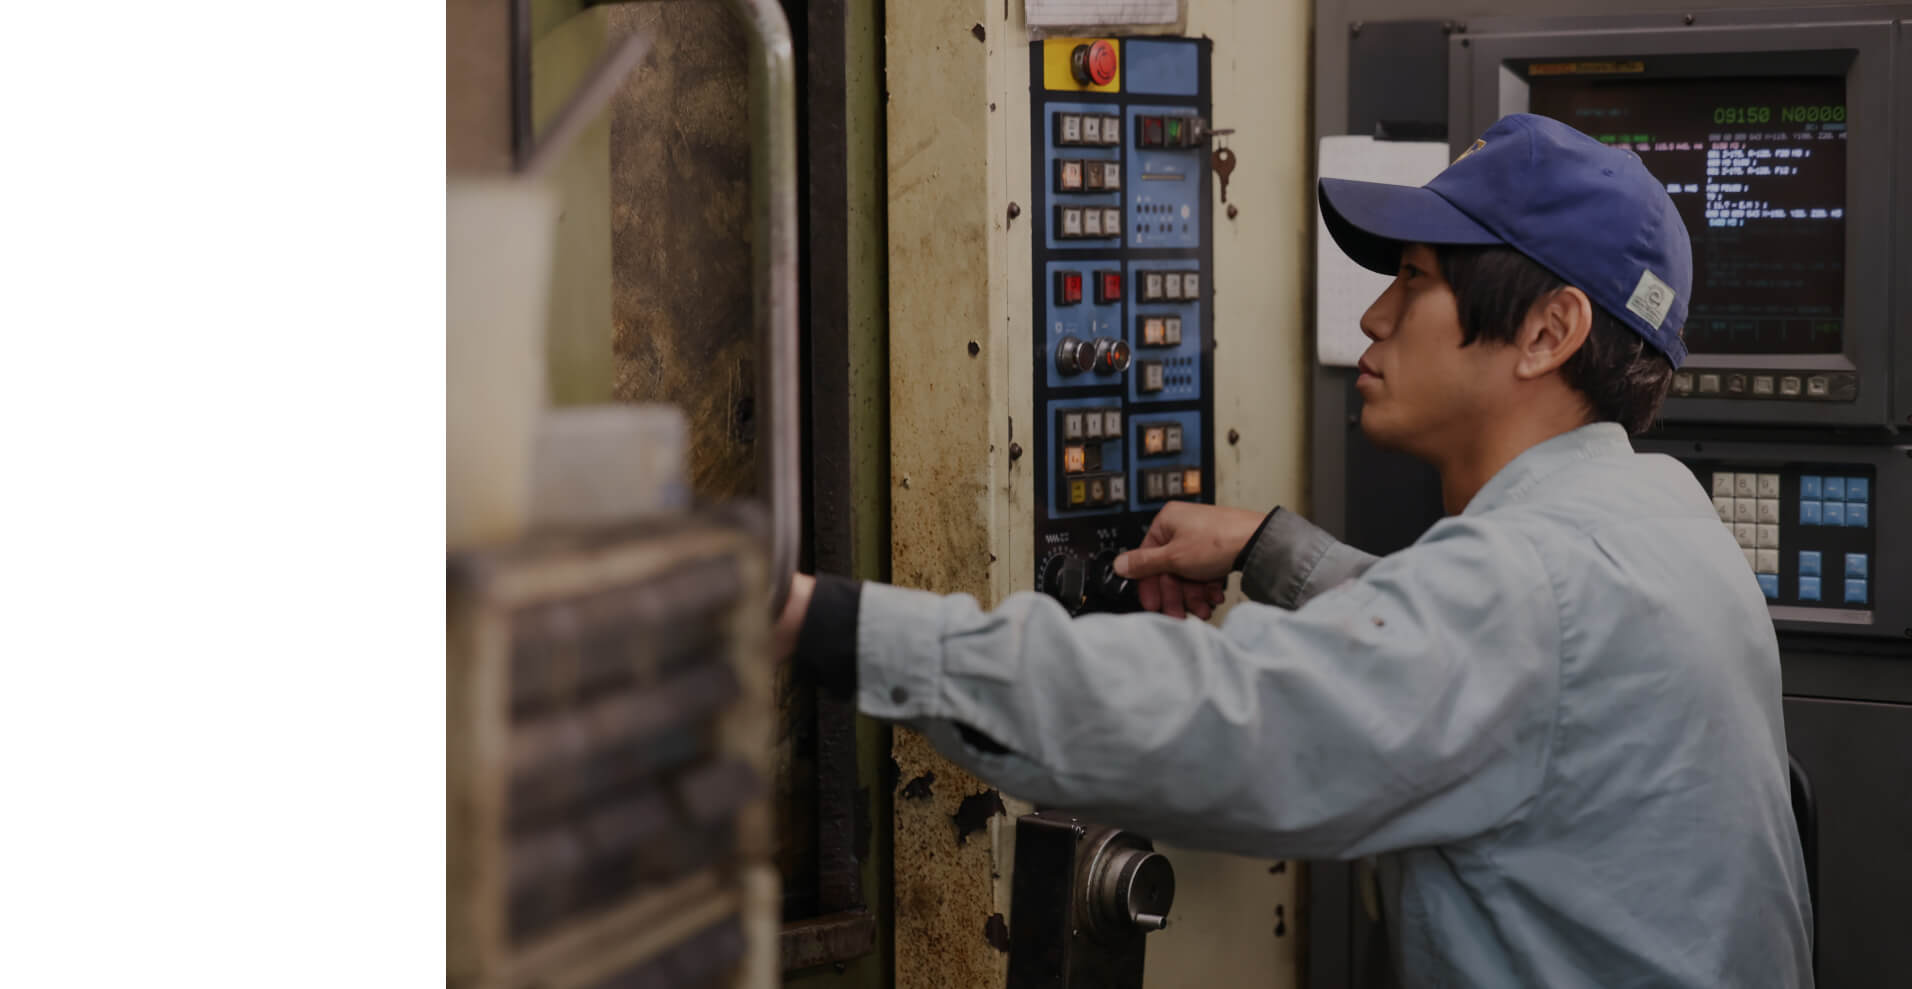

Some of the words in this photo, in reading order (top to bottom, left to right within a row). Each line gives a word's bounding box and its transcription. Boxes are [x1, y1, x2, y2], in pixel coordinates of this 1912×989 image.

[1739, 479, 1746, 488] 8
[1739, 504, 1746, 513] 5
[1761, 504, 1769, 514] 6
[1739, 529, 1747, 538] 2
[1761, 529, 1769, 538] 3
